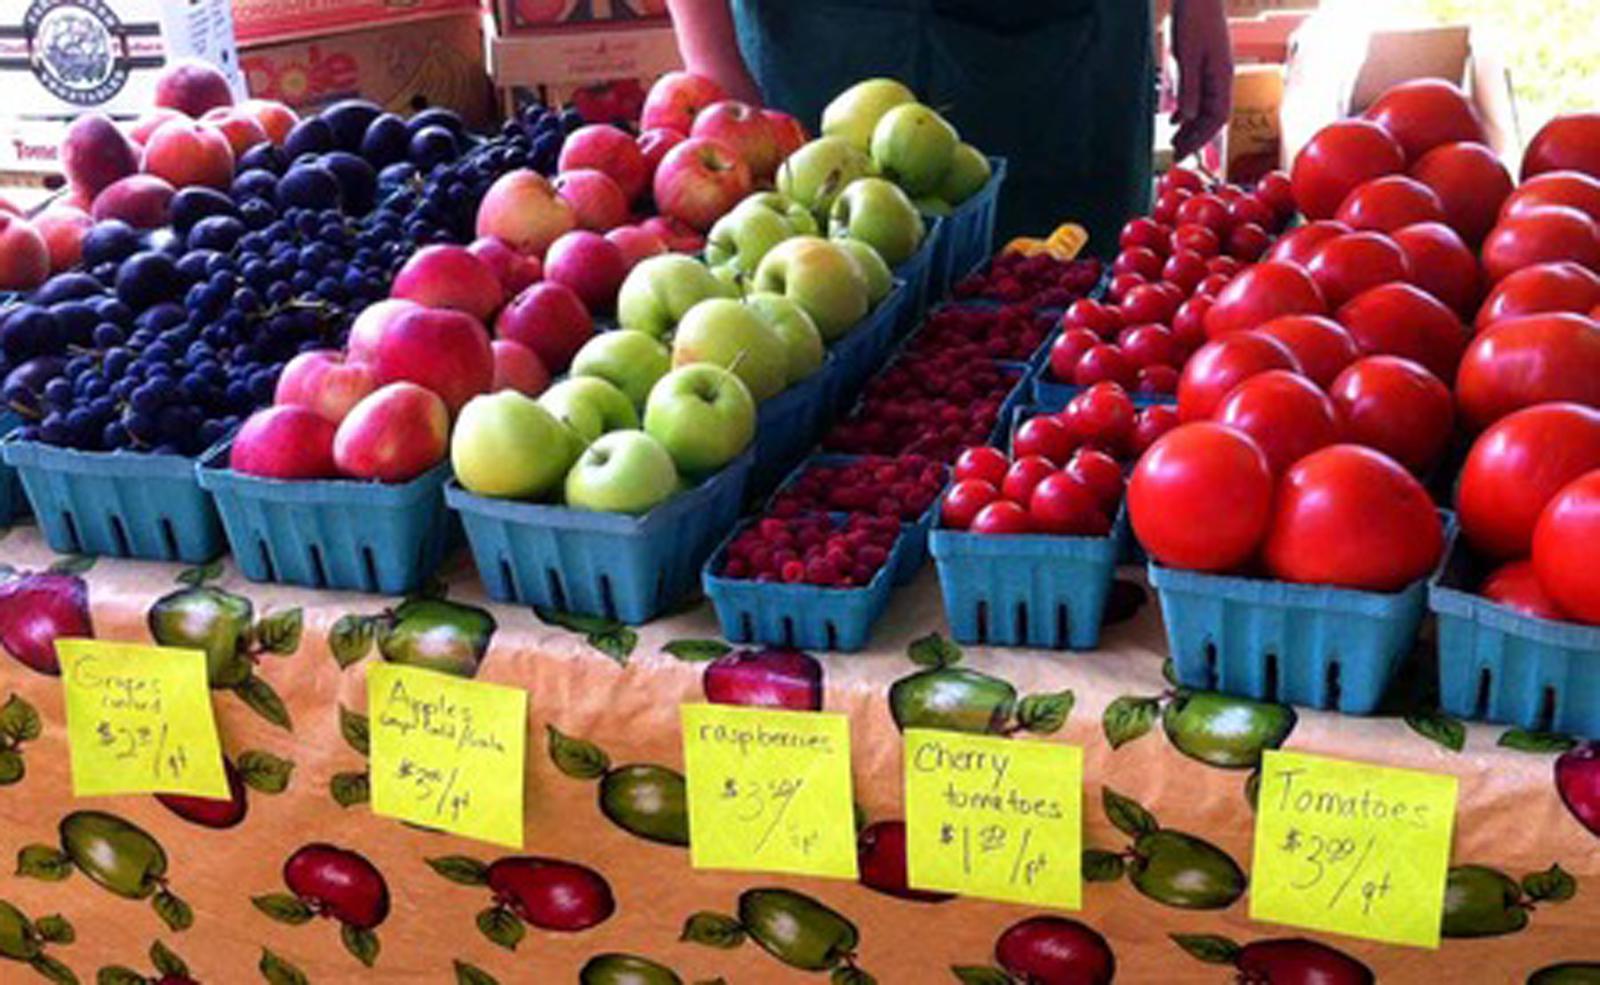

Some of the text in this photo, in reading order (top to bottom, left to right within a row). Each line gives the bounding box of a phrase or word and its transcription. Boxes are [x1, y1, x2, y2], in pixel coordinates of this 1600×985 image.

[74, 655, 162, 698] Grapes
[389, 679, 473, 727] Apples
[700, 723, 836, 756] raspberries
[914, 741, 1010, 789] Cherry
[942, 782, 1064, 819] tomatoes
[1274, 767, 1431, 831] Tomatoes
